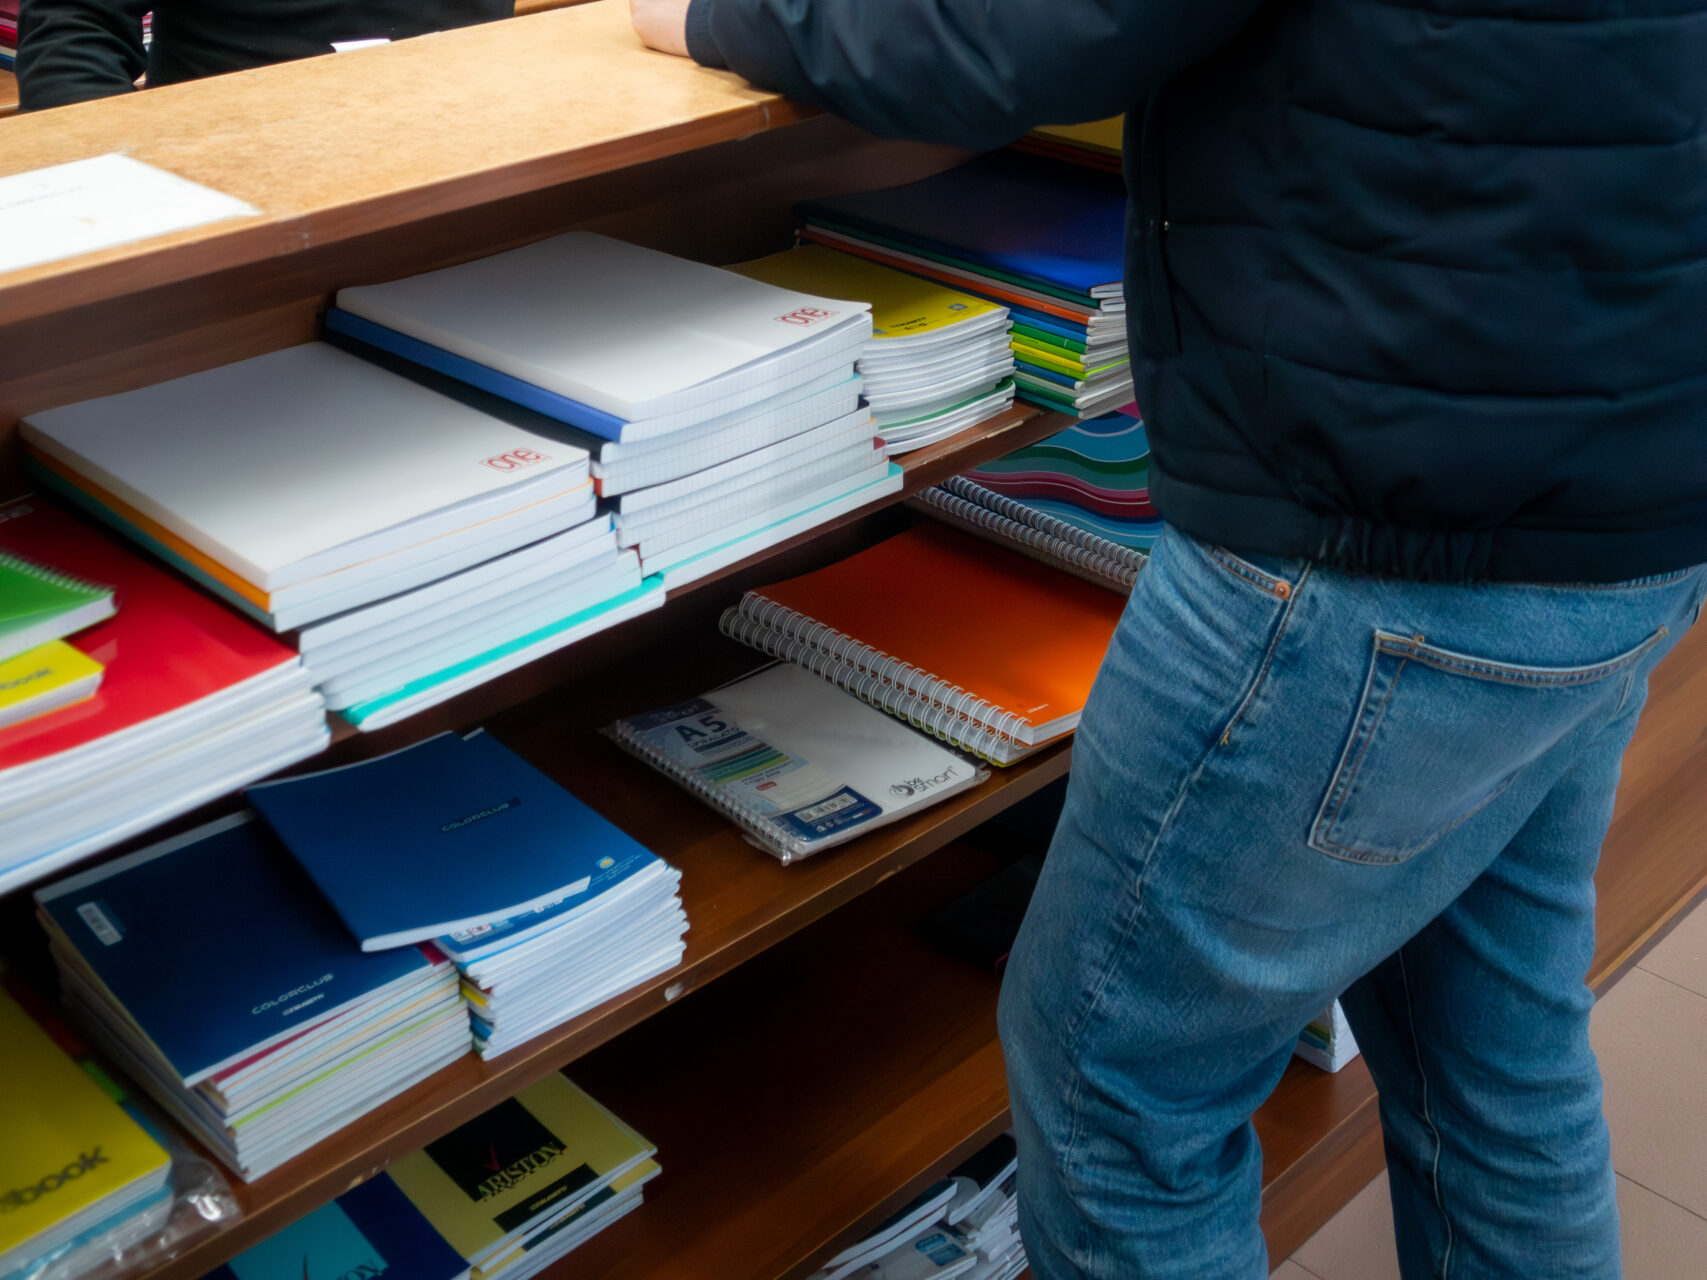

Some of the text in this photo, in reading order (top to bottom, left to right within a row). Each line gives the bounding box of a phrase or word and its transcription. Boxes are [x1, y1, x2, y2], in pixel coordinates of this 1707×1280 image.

[487, 449, 540, 470] one
[914, 766, 960, 793] smart
[441, 802, 510, 832] COLORCLUB
[251, 972, 335, 1015] COLORCLUB
[475, 1141, 566, 1202] ARISTON
